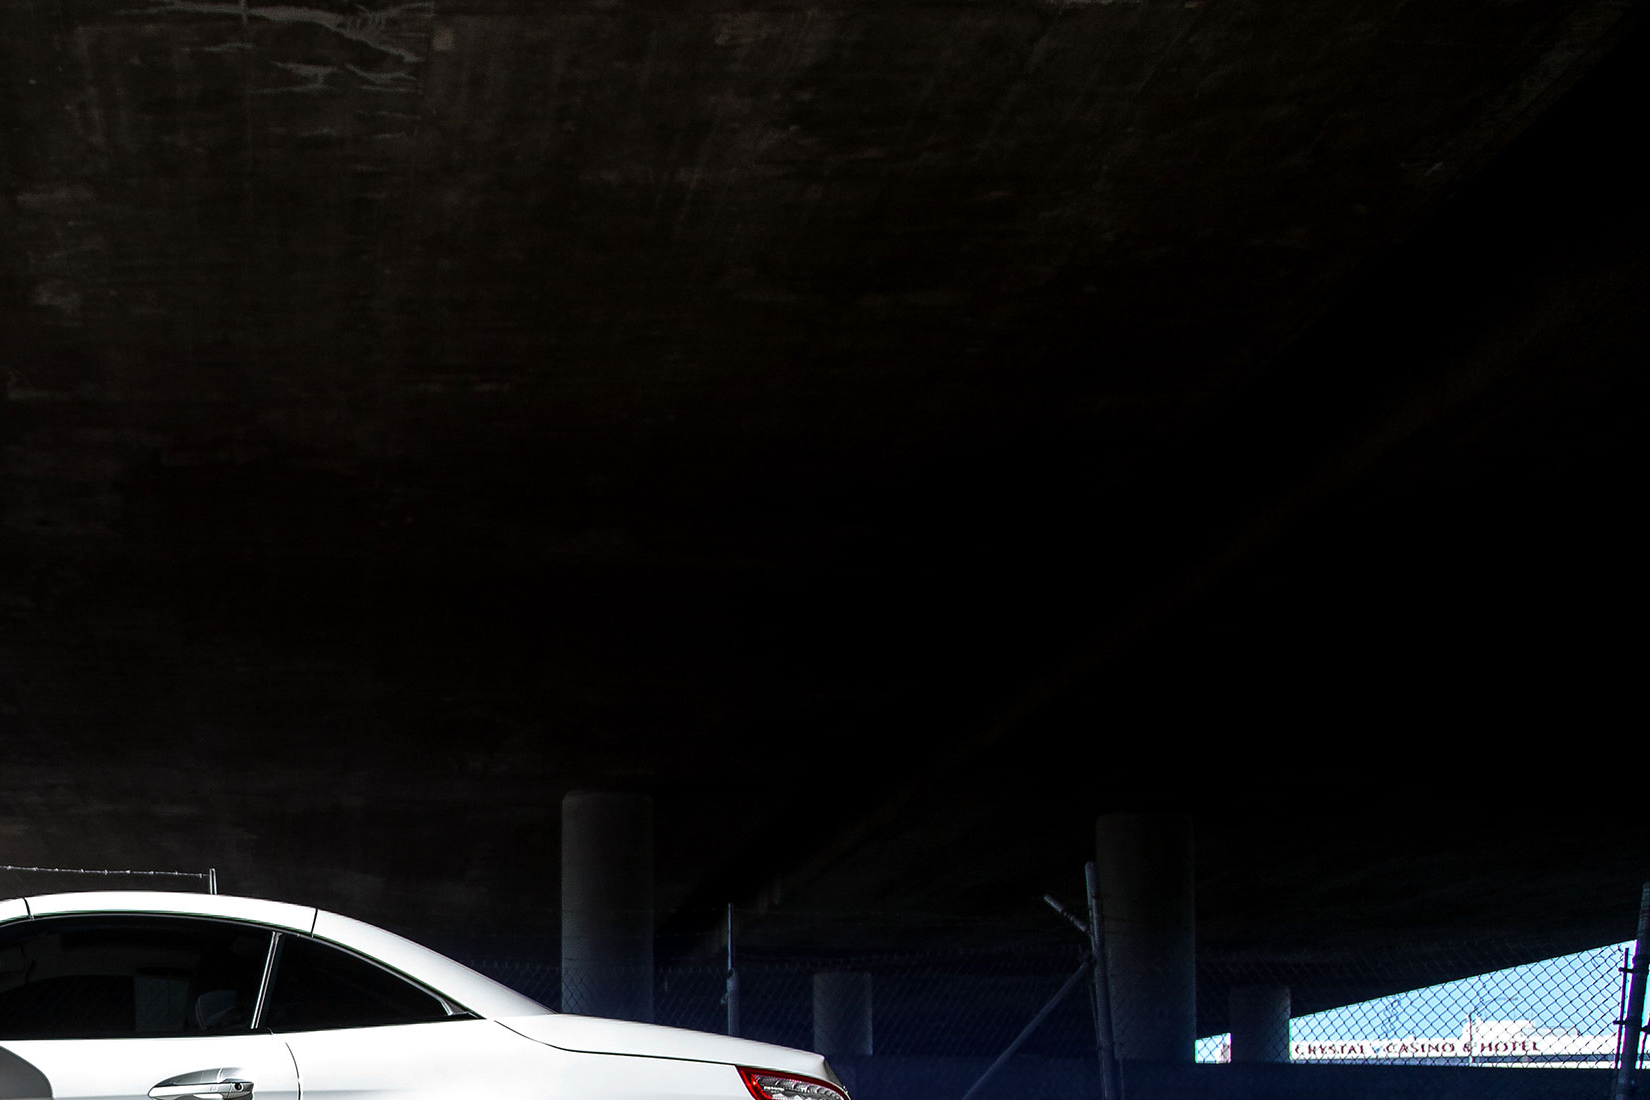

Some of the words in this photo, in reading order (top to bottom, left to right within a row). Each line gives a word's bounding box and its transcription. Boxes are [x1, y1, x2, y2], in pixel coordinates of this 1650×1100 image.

[1294, 1043, 1367, 1054] CRYSTAL
[1385, 1042, 1455, 1054] CASINO
[1480, 1041, 1541, 1053] HOTEL
